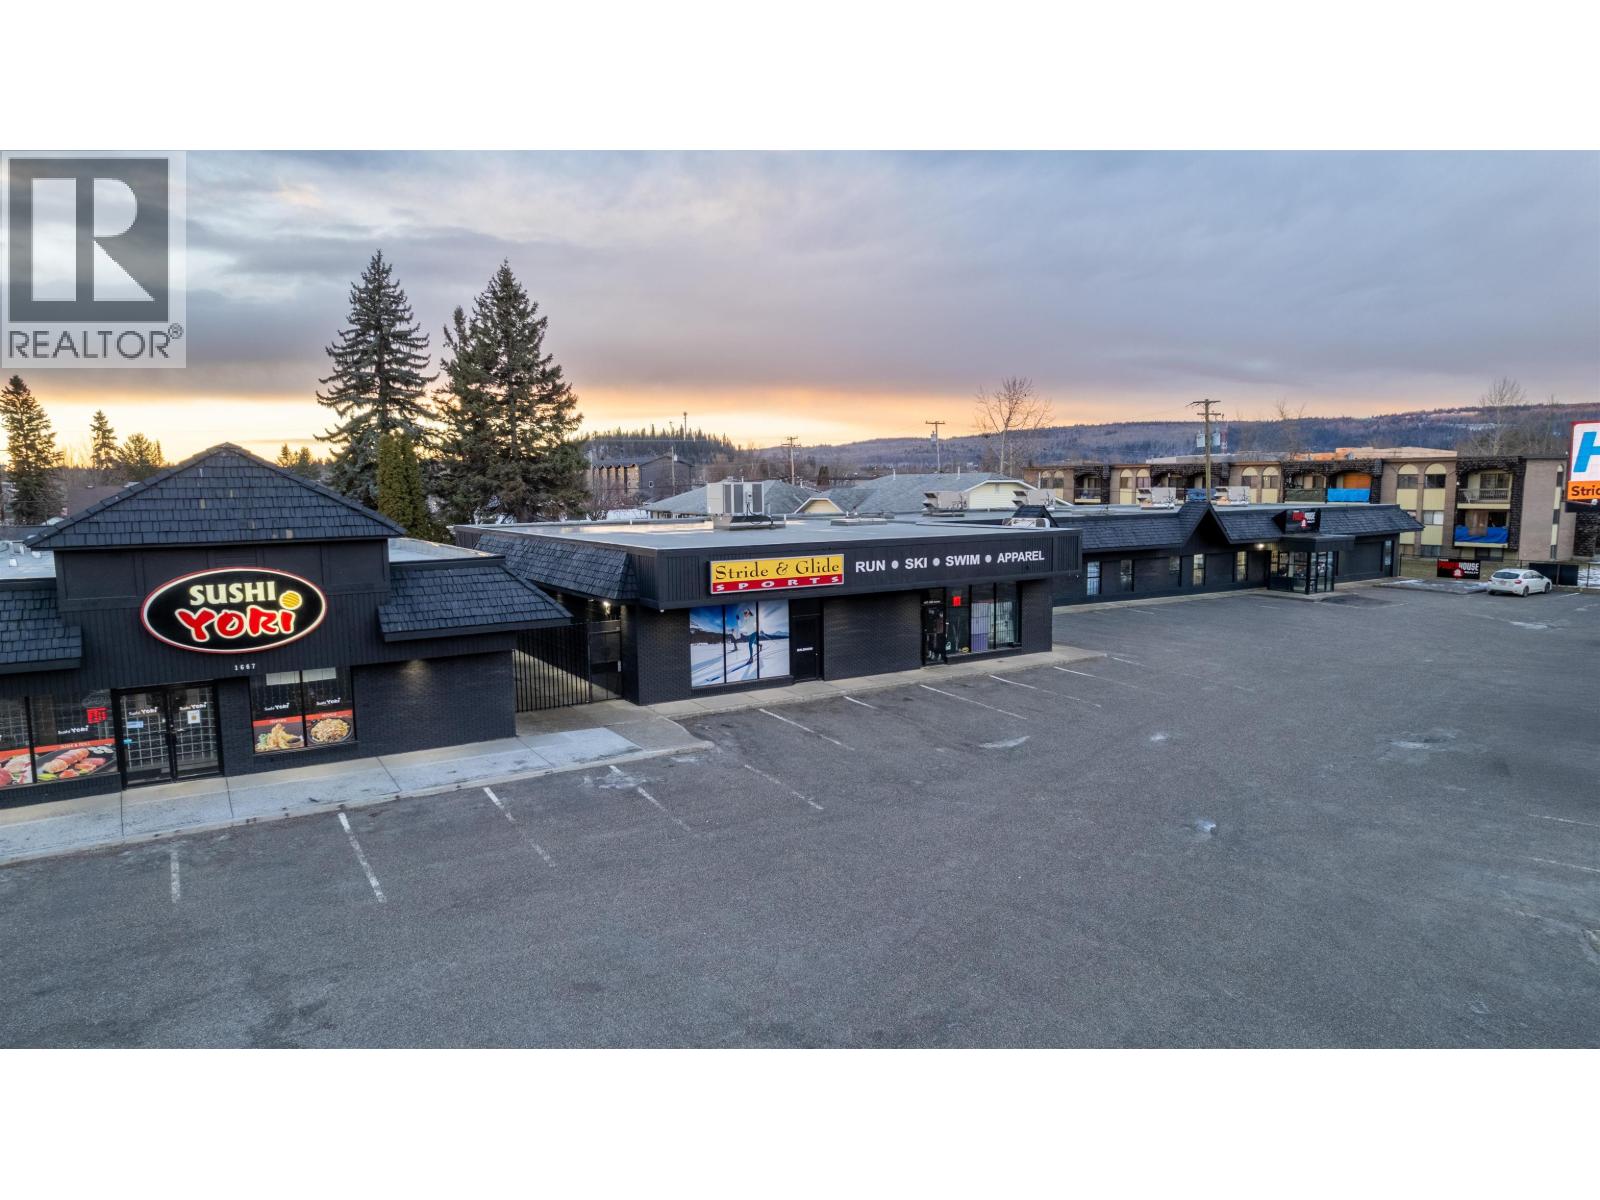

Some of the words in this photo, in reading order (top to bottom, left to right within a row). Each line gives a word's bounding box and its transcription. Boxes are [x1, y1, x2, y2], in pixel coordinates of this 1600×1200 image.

[715, 561, 769, 580] Stride
[776, 562, 788, 576] &
[795, 557, 840, 575] Glide
[855, 560, 886, 573] RUN
[905, 557, 928, 570] SKI
[945, 554, 980, 567] SWIM
[997, 550, 1045, 563] APPAREL
[189, 581, 277, 606] SUSHI
[716, 576, 840, 592] SPORTS
